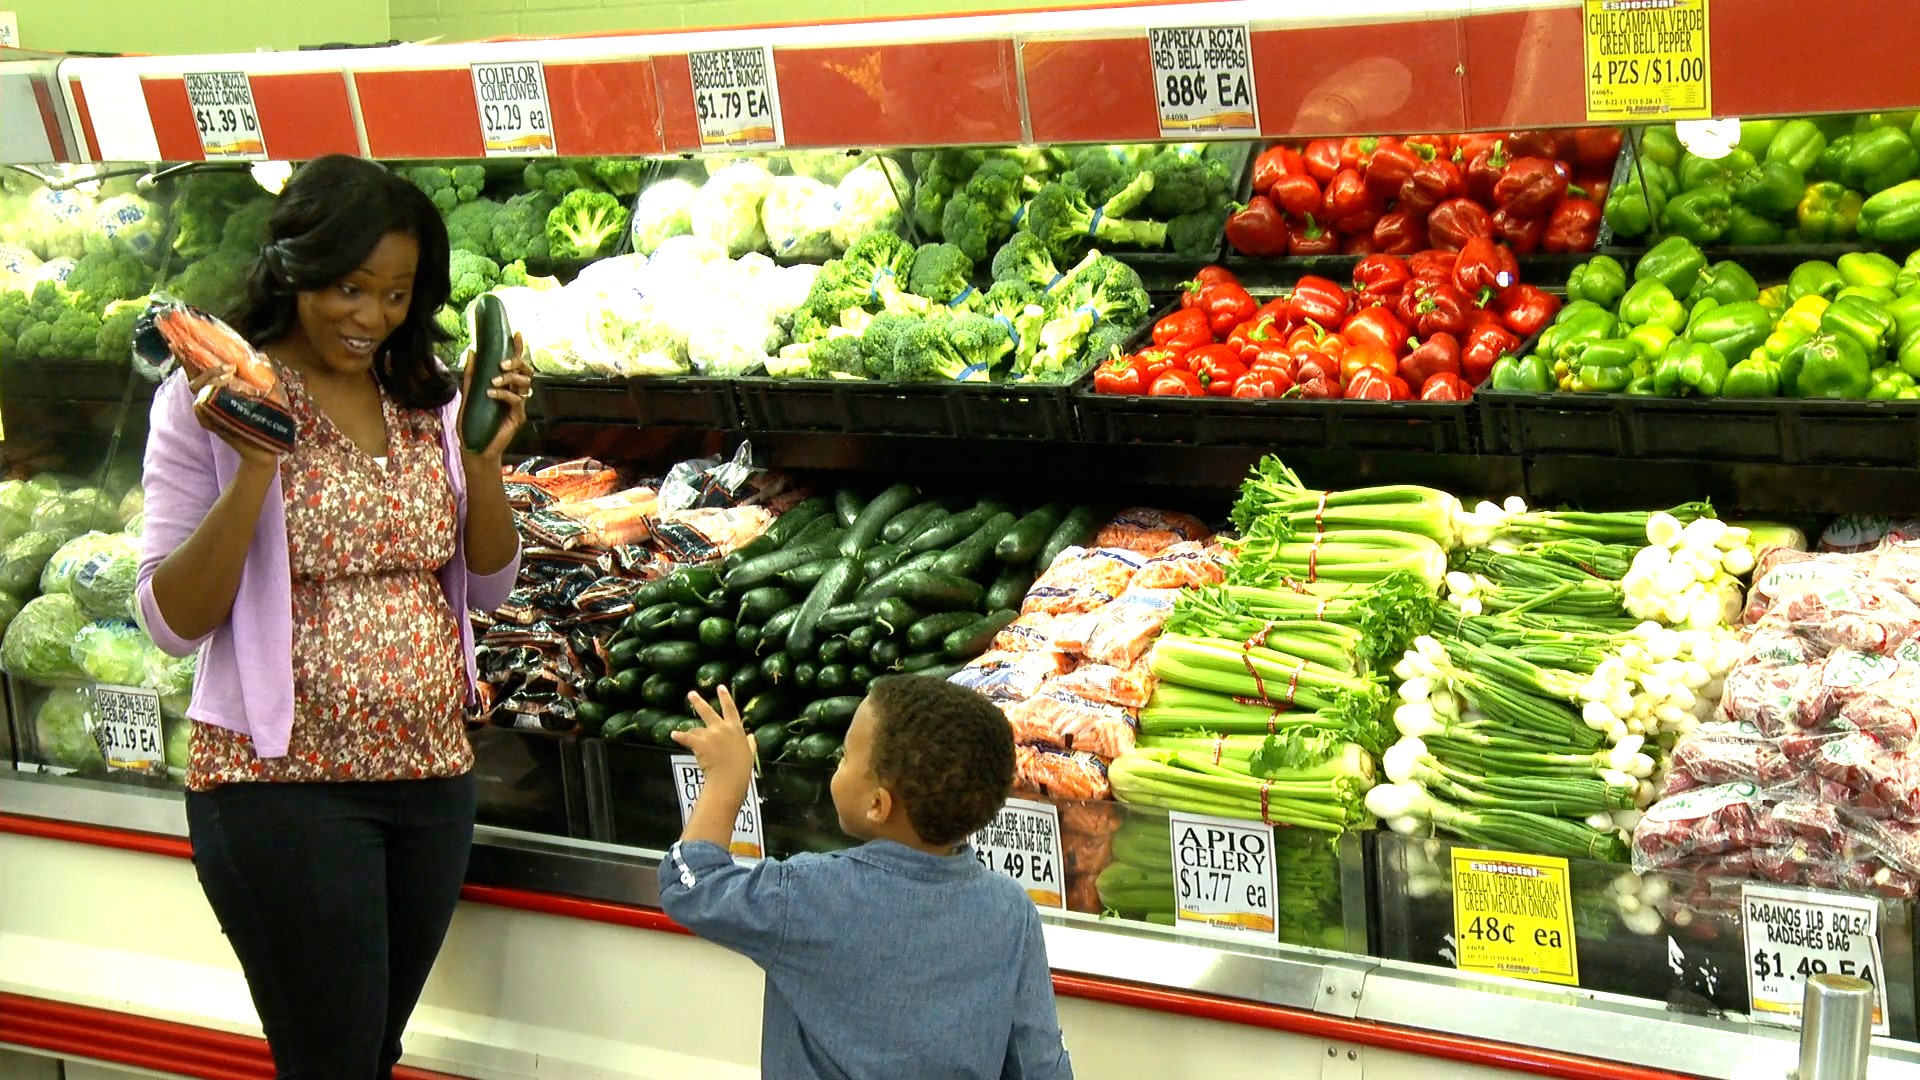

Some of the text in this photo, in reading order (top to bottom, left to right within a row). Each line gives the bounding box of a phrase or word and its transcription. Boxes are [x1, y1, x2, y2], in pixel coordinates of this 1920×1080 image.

[1590, 9, 1703, 35] CHILE CAMPANA VERDE
[1153, 29, 1243, 49] PAPRIKA ROJA
[1600, 31, 1692, 55] GREEN BELL PEPPER
[692, 53, 719, 72] BONCHE
[720, 52, 731, 70] DE
[1155, 49, 1246, 70] RED BELL PEPPERS
[1591, 61, 1602, 85] 4
[1608, 59, 1639, 84] PZS
[212, 74, 221, 91] DE
[478, 66, 538, 85] COLIFLOR
[694, 69, 765, 90] BROCCOLI BUNCH
[190, 89, 250, 106] BROCCOLI CROWNS
[481, 83, 541, 102] COLIFLOWER
[1161, 70, 1250, 108] .88¢ EA
[484, 102, 545, 133] $2.29 ea
[698, 90, 769, 125] $1.79 EA
[196, 108, 256, 136] $1.39 lb
[129, 710, 157, 729] LETTUCE
[105, 726, 137, 751] $1.19
[1004, 812, 1019, 832] BEBE
[1019, 814, 1026, 833] 16
[1027, 816, 1035, 835] OZ
[1036, 816, 1053, 837] BOLSA
[990, 829, 1015, 849] CARROTS
[1015, 832, 1023, 851] IN
[1024, 833, 1035, 853] BAG
[1035, 835, 1043, 854] 16
[1044, 837, 1052, 855] OZ
[1178, 827, 1266, 855] APIO
[975, 846, 1054, 883] $149 EA
[1180, 846, 1266, 875] CELERY
[1180, 865, 1266, 908] $1.77 ea
[1457, 872, 1561, 902] CEBOLLA VERDE MEXICANA
[1464, 891, 1558, 920] GREEN MEXICAN ONIONS
[1750, 903, 1801, 928] RABANOS
[1806, 909, 1824, 930] 1LB
[1461, 916, 1562, 948] .48¢ ea
[1767, 925, 1850, 952] RADISHES BAG
[1762, 985, 1778, 993] 4744
